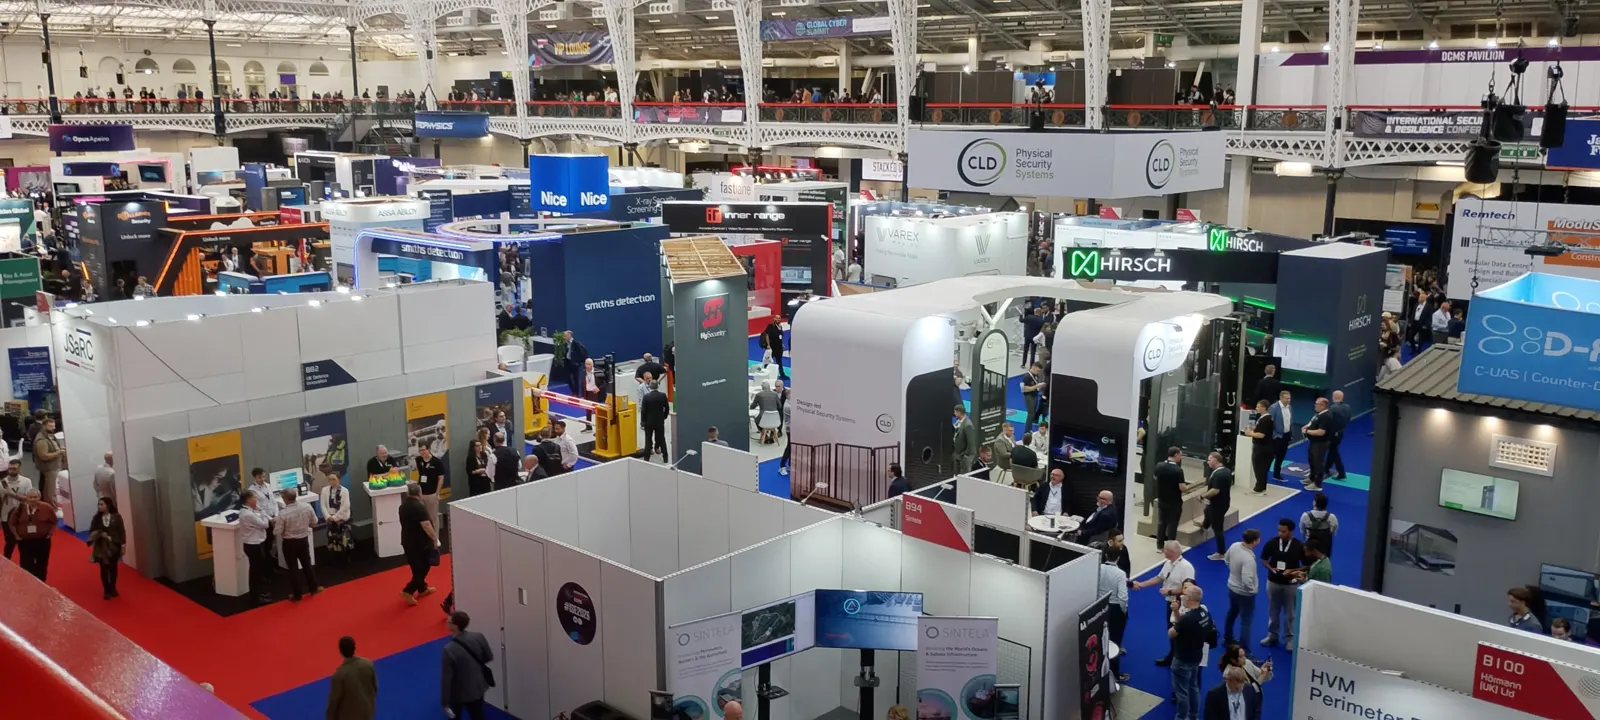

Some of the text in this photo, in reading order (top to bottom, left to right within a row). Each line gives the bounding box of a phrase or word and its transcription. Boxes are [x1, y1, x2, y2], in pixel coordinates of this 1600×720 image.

[807, 18, 847, 29] GLOBAL CYBER
[554, 41, 591, 56] VIP LOUNGE
[1441, 50, 1505, 62] DCMS PAVILION
[1386, 116, 1454, 125] INTERNATIONAL
[1384, 125, 1392, 133] &
[1394, 125, 1444, 134] RESILIENCE
[1016, 148, 1053, 159] Physical
[1179, 146, 1199, 157] Physical
[1589, 145, 1600, 156] F
[873, 161, 897, 173] STACKED
[968, 156, 997, 170] CLD
[1016, 159, 1052, 169] Security
[1152, 158, 1170, 172] CLD
[1179, 157, 1198, 168] Security
[1016, 169, 1054, 179] Systems
[720, 181, 751, 196] fastlane
[541, 190, 567, 207] Nice
[580, 191, 608, 206] Nice
[635, 195, 677, 206] X-ray Security
[378, 208, 417, 217] ASSA ABLOY
[627, 203, 659, 214] Screening
[1462, 209, 1516, 220] Remtech
[753, 212, 785, 222] range
[887, 228, 920, 242] VAREX
[1225, 236, 1264, 252] HIRSCH
[401, 244, 464, 261] smiths detection
[1101, 256, 1171, 273] HIRSCH
[1491, 260, 1507, 268] Data
[1468, 267, 1493, 277] Design
[1494, 268, 1504, 276] and
[584, 293, 656, 311] smiths detection
[1348, 314, 1372, 331] HIRSCH
[64, 333, 94, 361] JSaRC
[1148, 348, 1162, 360] CLD
[1475, 365, 1520, 380] C-UAS
[796, 398, 822, 409] Design-led
[796, 405, 816, 416] Physical
[816, 410, 835, 421] Security
[879, 419, 892, 428] CLD
[905, 501, 922, 513] B94
[693, 624, 735, 643] SINTELA
[942, 627, 990, 639] SINTELA
[1310, 668, 1356, 695] HVM
[1480, 672, 1522, 690] Hörmann
[1500, 687, 1515, 698] Ltd
[1309, 687, 1404, 720] Perimeter
